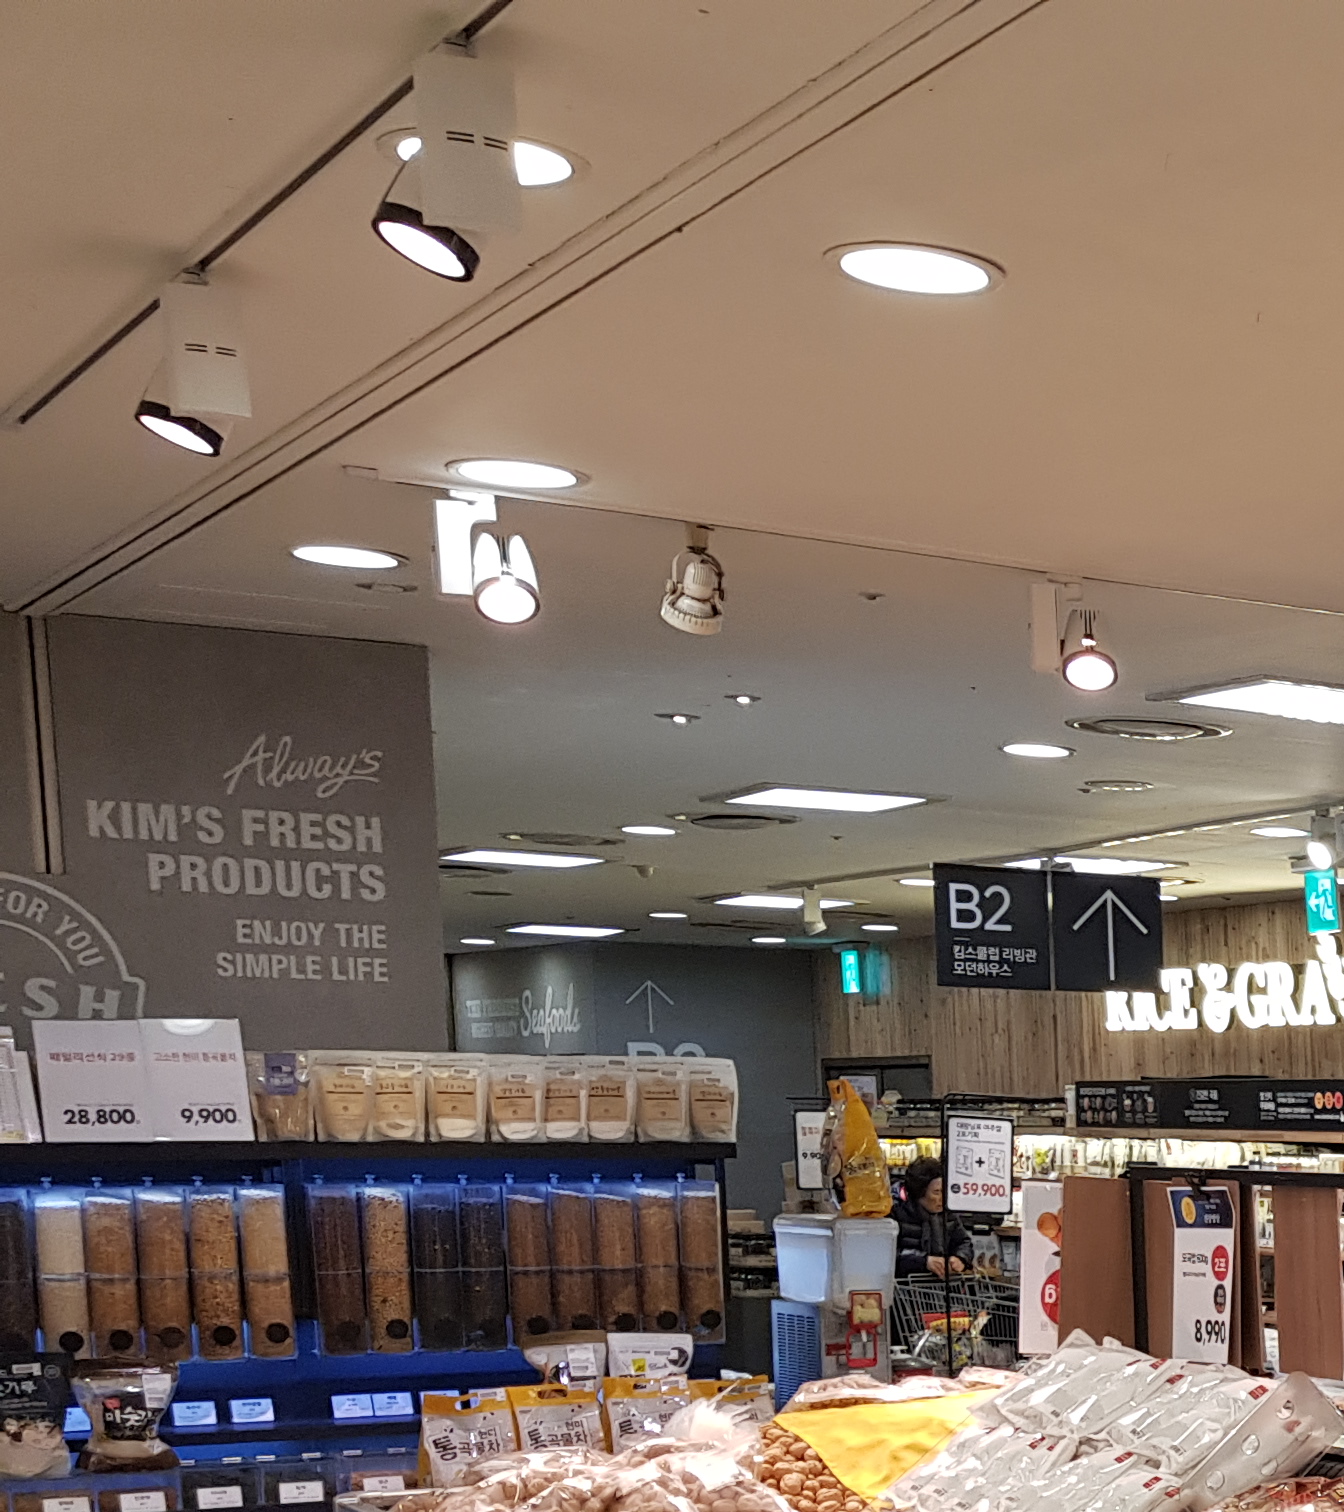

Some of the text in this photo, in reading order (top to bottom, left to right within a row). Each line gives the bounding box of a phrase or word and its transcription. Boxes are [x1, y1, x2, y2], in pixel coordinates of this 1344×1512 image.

[87, 799, 383, 853] KIM'S FRESH
[147, 853, 386, 901] PRODUCTS
[948, 882, 1013, 932] B2
[0, 887, 107, 969] OR YOU
[236, 919, 388, 950] ENJOY THE
[216, 952, 390, 983] SIMPLE LIFE
[953, 961, 1013, 977] 모던하우스
[1001, 947, 1038, 963] 리빙관
[521, 982, 581, 1049] Seafoods
[63, 1108, 136, 1127] 28,800
[180, 1108, 237, 1127] 9,900
[962, 1182, 1006, 1198] 59,900
[1194, 1318, 1226, 1346] 8,990
